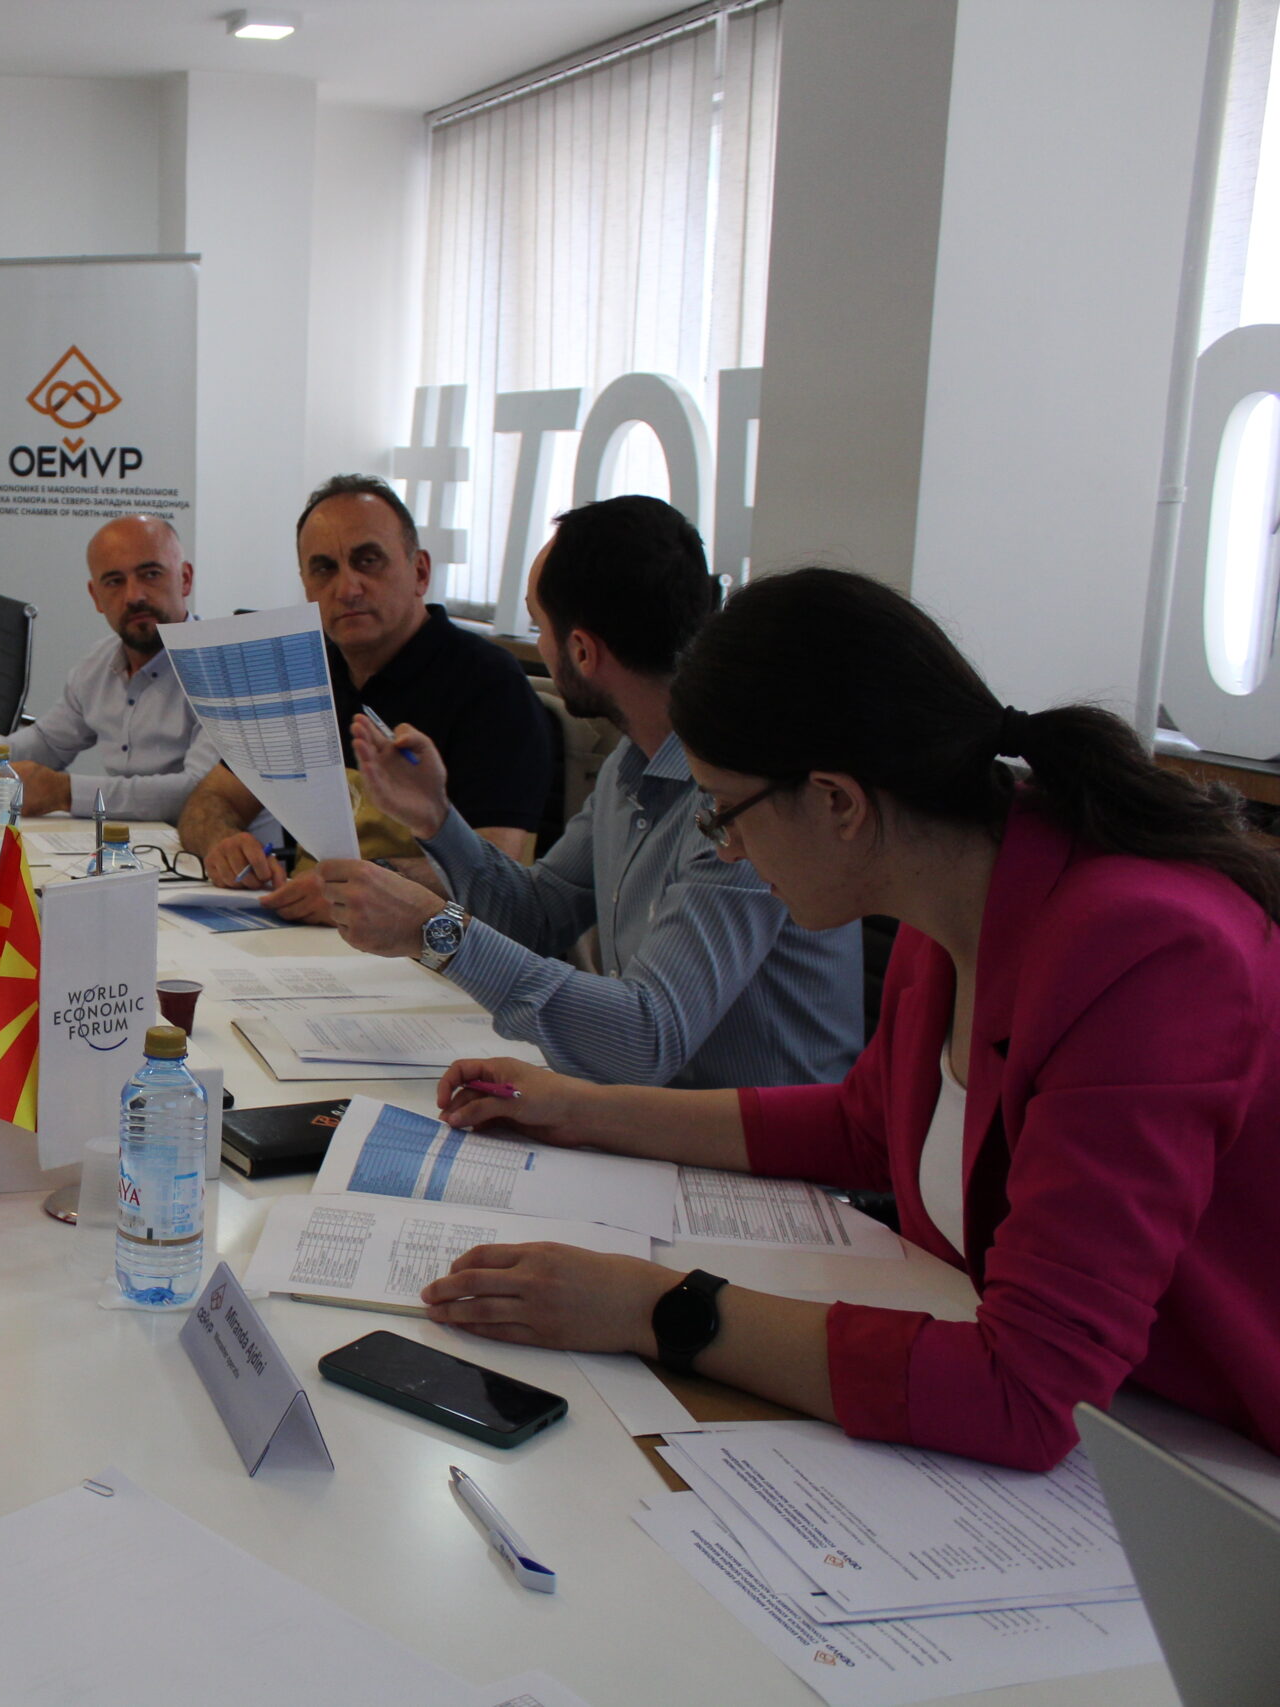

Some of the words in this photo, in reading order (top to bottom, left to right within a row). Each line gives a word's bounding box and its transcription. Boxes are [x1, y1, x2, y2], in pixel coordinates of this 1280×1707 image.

[9, 446, 143, 479] OEMVP
[21, 507, 58, 516] CHAMBER
[68, 983, 128, 1005] WORLD
[53, 997, 144, 1026] ECONOMIC
[69, 1017, 128, 1041] FORUM
[225, 1305, 250, 1350] Miranda
